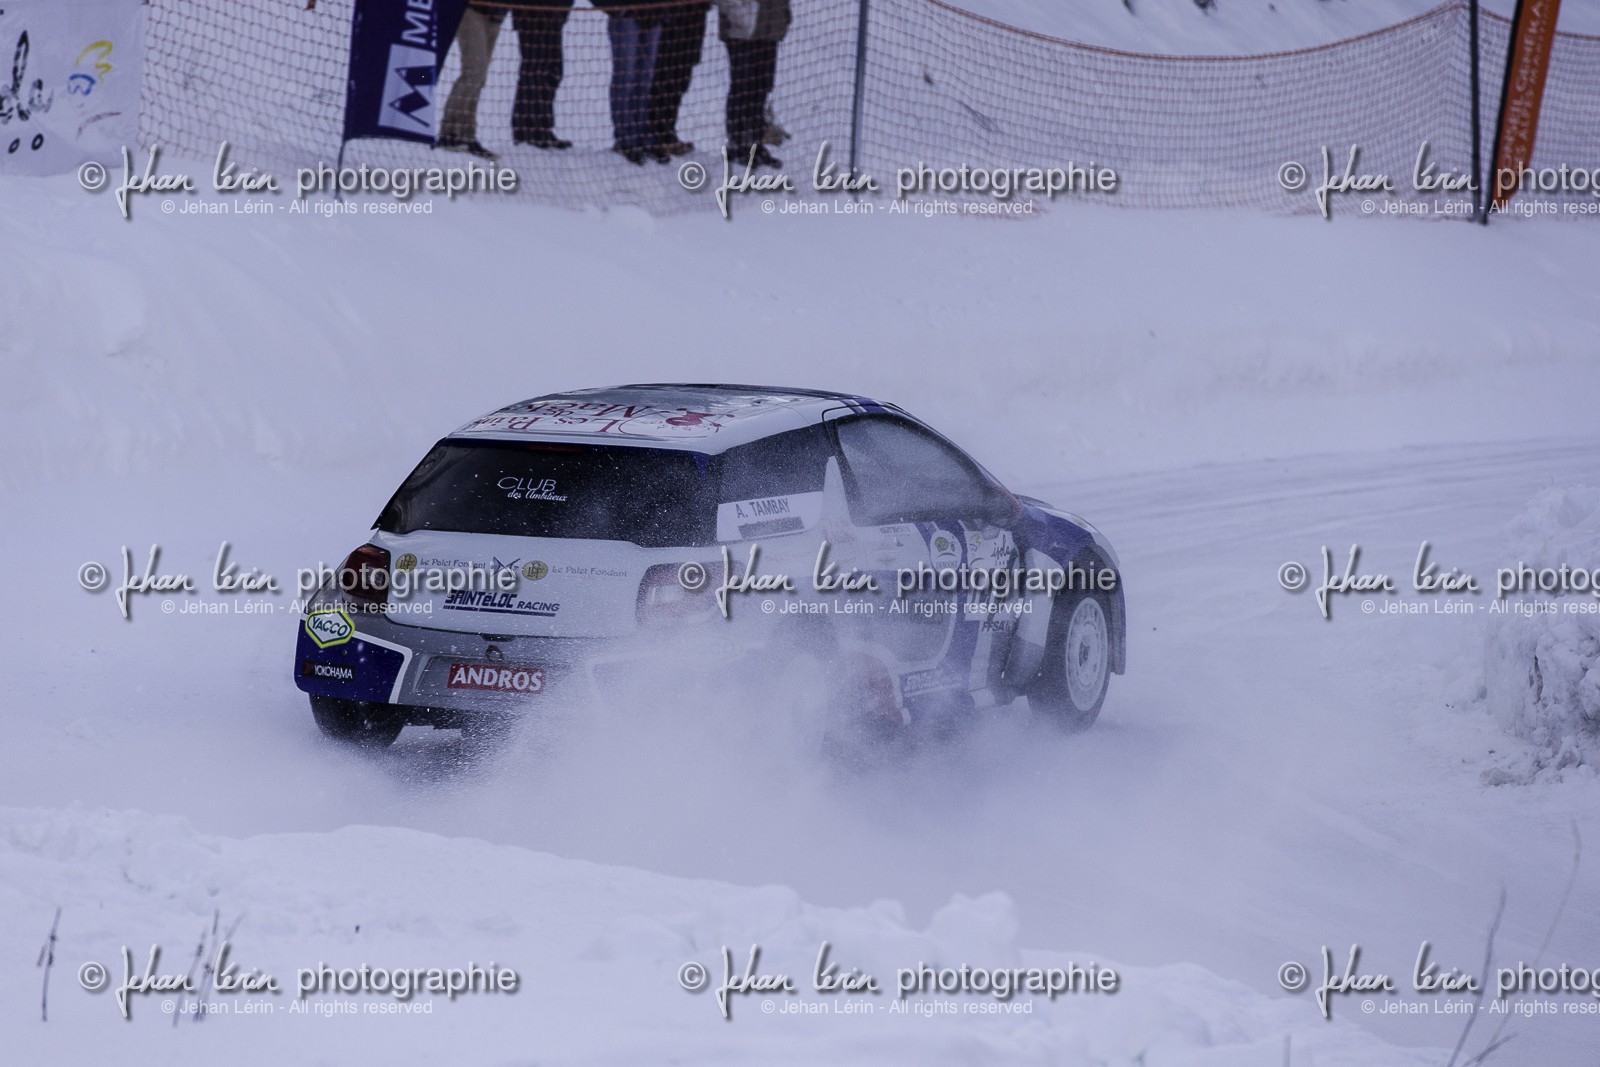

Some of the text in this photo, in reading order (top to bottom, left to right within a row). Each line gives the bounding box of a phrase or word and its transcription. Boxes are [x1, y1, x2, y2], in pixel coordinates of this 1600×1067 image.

[497, 476, 557, 492] CLUB
[735, 498, 791, 518] A. TAMBAY
[517, 601, 560, 612] RACING
[311, 616, 349, 638] YACCO
[313, 663, 353, 680] YOKOHAMA
[451, 666, 543, 692] ANDROS
